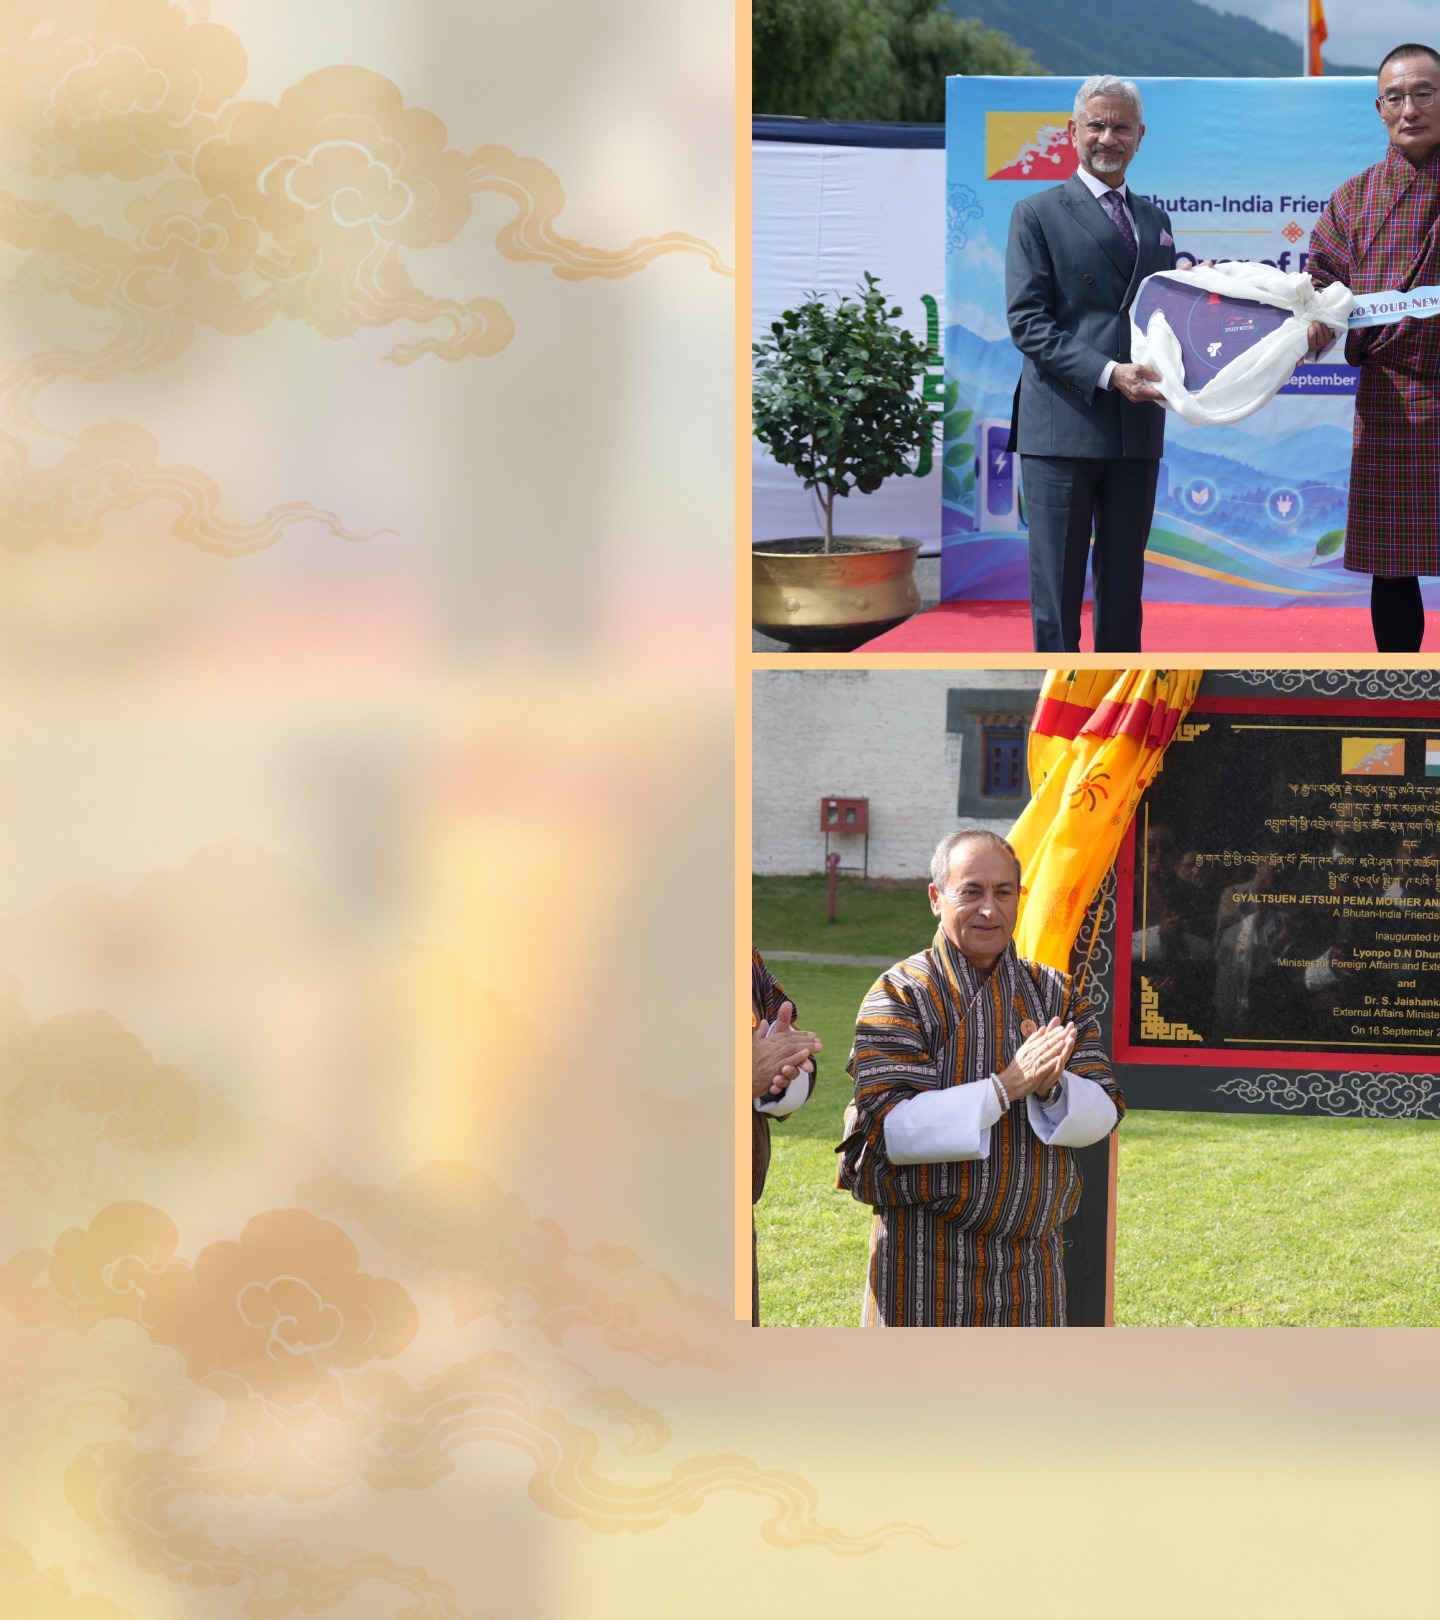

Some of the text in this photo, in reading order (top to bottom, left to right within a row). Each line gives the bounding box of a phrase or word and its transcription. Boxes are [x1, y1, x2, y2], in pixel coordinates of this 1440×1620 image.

[1370, 301, 1408, 315] YOUR
[1412, 296, 1440, 309] NEW
[1232, 893, 1297, 904] GYALTSUEN
[1298, 895, 1341, 905] JETSUN
[1343, 896, 1373, 906] PEMA
[1375, 897, 1422, 907] MOTHER
[1332, 908, 1341, 917] A
[1343, 908, 1401, 919] Bhutan-India
[1376, 931, 1431, 943] Inaugurated
[1353, 948, 1391, 959] Lyonpo
[1393, 949, 1412, 958] D.N
[1277, 958, 1314, 968] Minister
[1315, 958, 1329, 968] for
[1331, 959, 1367, 971] Foreign
[1369, 960, 1399, 970] Affairs
[1401, 961, 1419, 971] and
[1397, 979, 1416, 988] and
[1364, 996, 1379, 1005] Dr.
[1381, 996, 1391, 1006] S.
[1333, 1008, 1372, 1017] External
[1374, 1008, 1404, 1018] Affairs
[1351, 1026, 1366, 1035] On
[1368, 1027, 1380, 1035] 16
[1382, 1027, 1434, 1038] September
